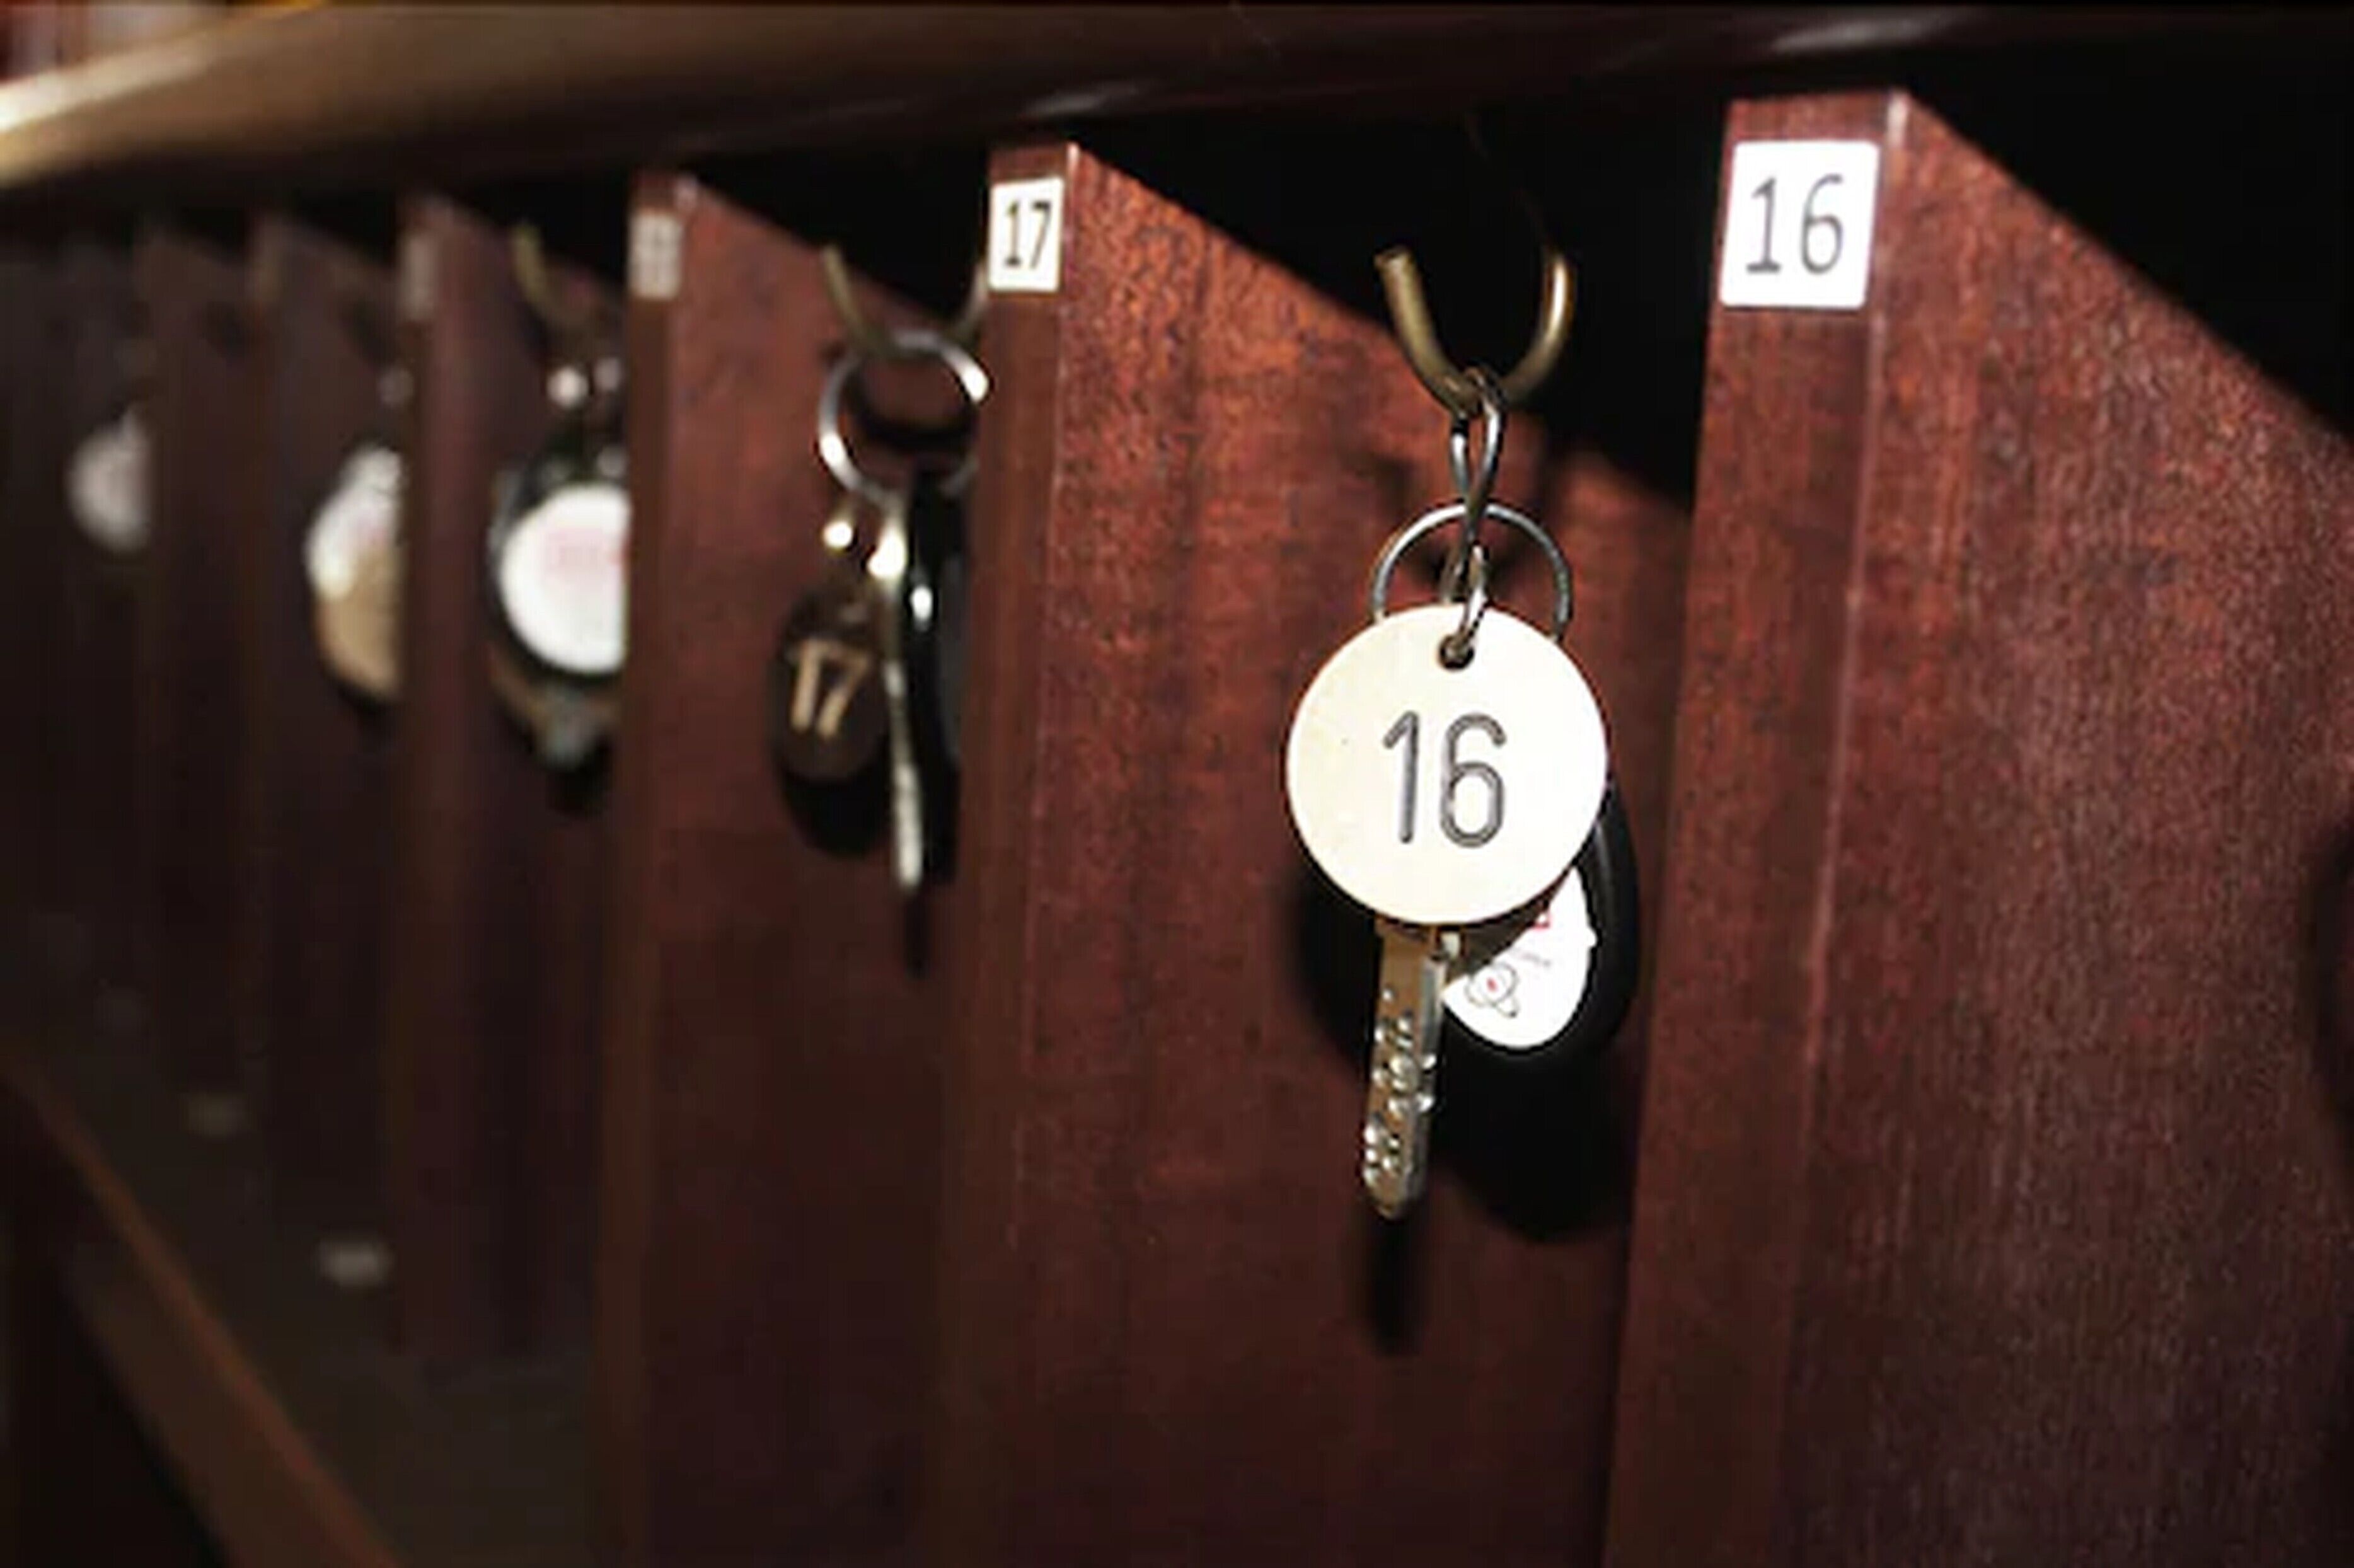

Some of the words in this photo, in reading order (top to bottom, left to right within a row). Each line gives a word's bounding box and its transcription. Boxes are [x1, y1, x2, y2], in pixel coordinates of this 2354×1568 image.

[1005, 200, 1053, 270] 17
[1745, 174, 1843, 276] 16
[790, 639, 868, 739] 17
[1382, 710, 1505, 849] 16
